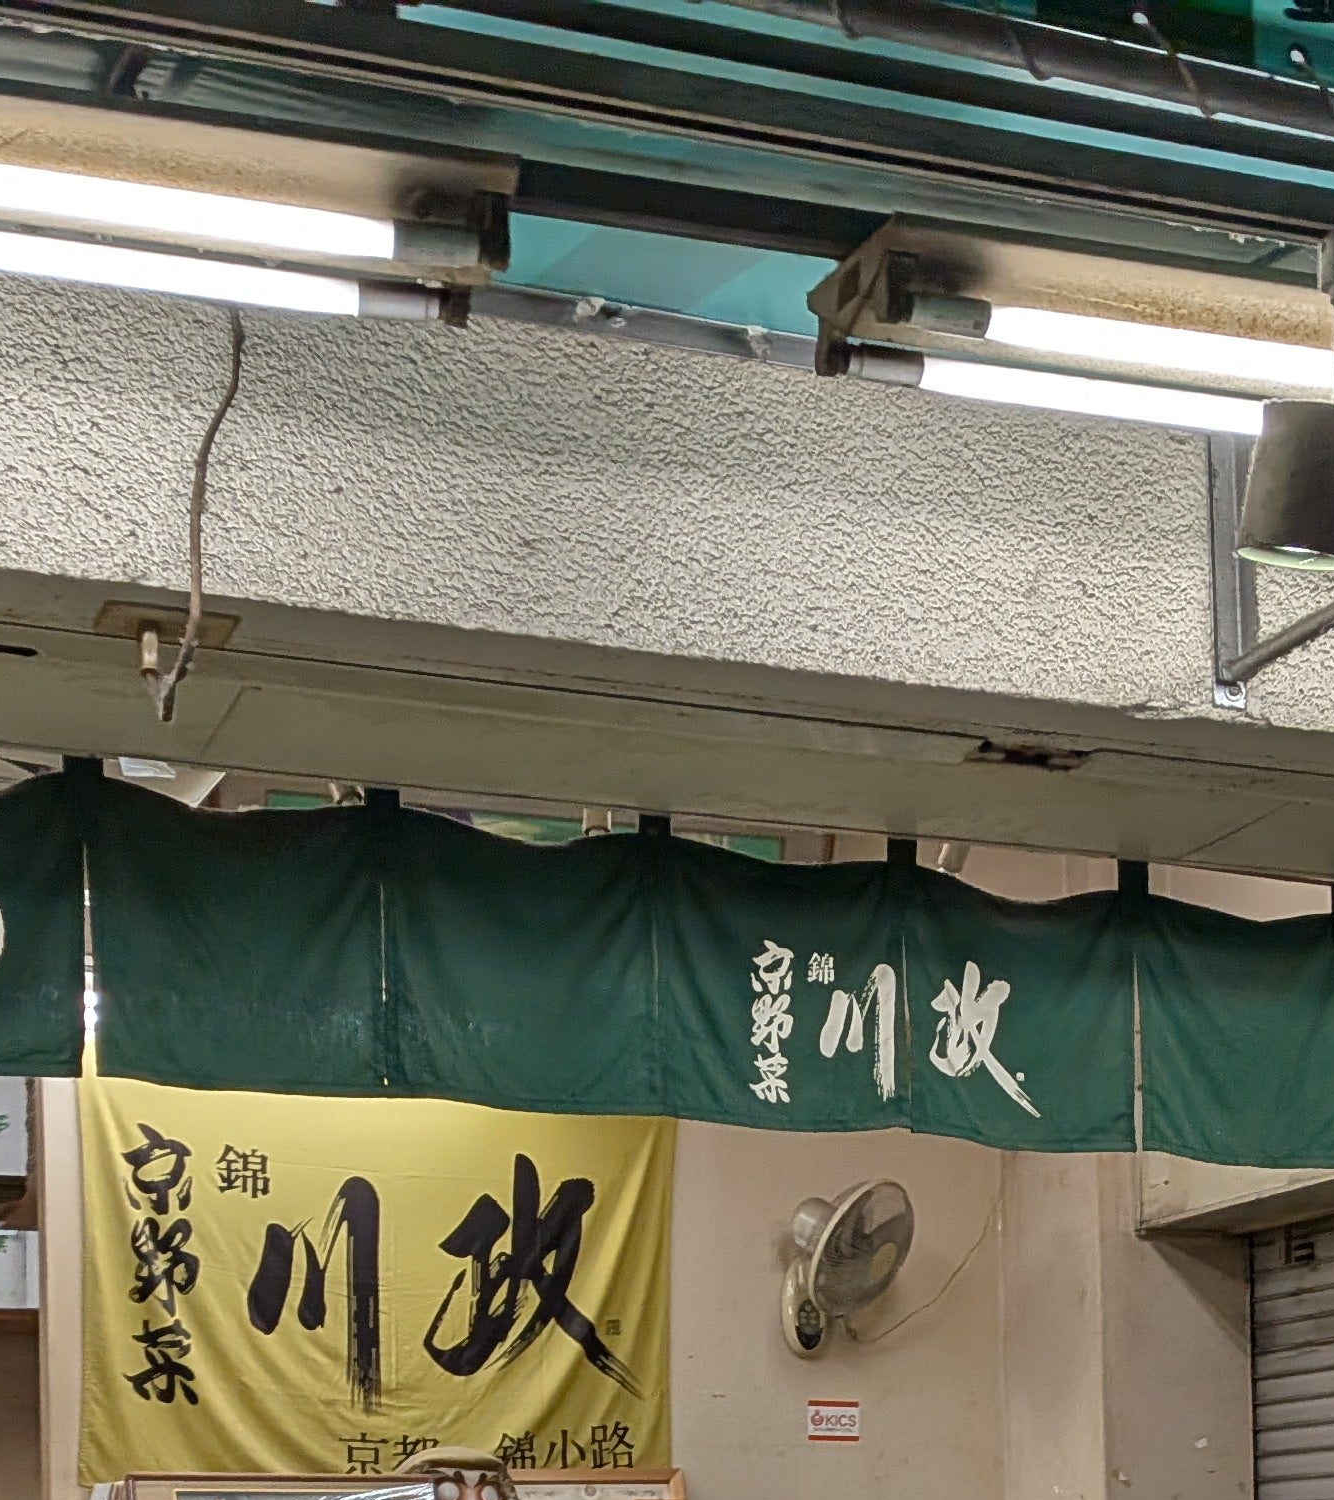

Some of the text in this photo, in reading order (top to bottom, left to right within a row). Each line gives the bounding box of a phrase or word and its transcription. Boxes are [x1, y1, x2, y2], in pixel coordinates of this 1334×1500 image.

[749, 939, 794, 1103] 京野菜
[807, 951, 835, 985] 錦
[819, 960, 1041, 1118] 川政
[216, 1143, 270, 1198] 錦
[121, 1122, 200, 1406] 京野菜
[248, 1153, 644, 1418] 川政
[494, 1420, 636, 1470] 錦小路
